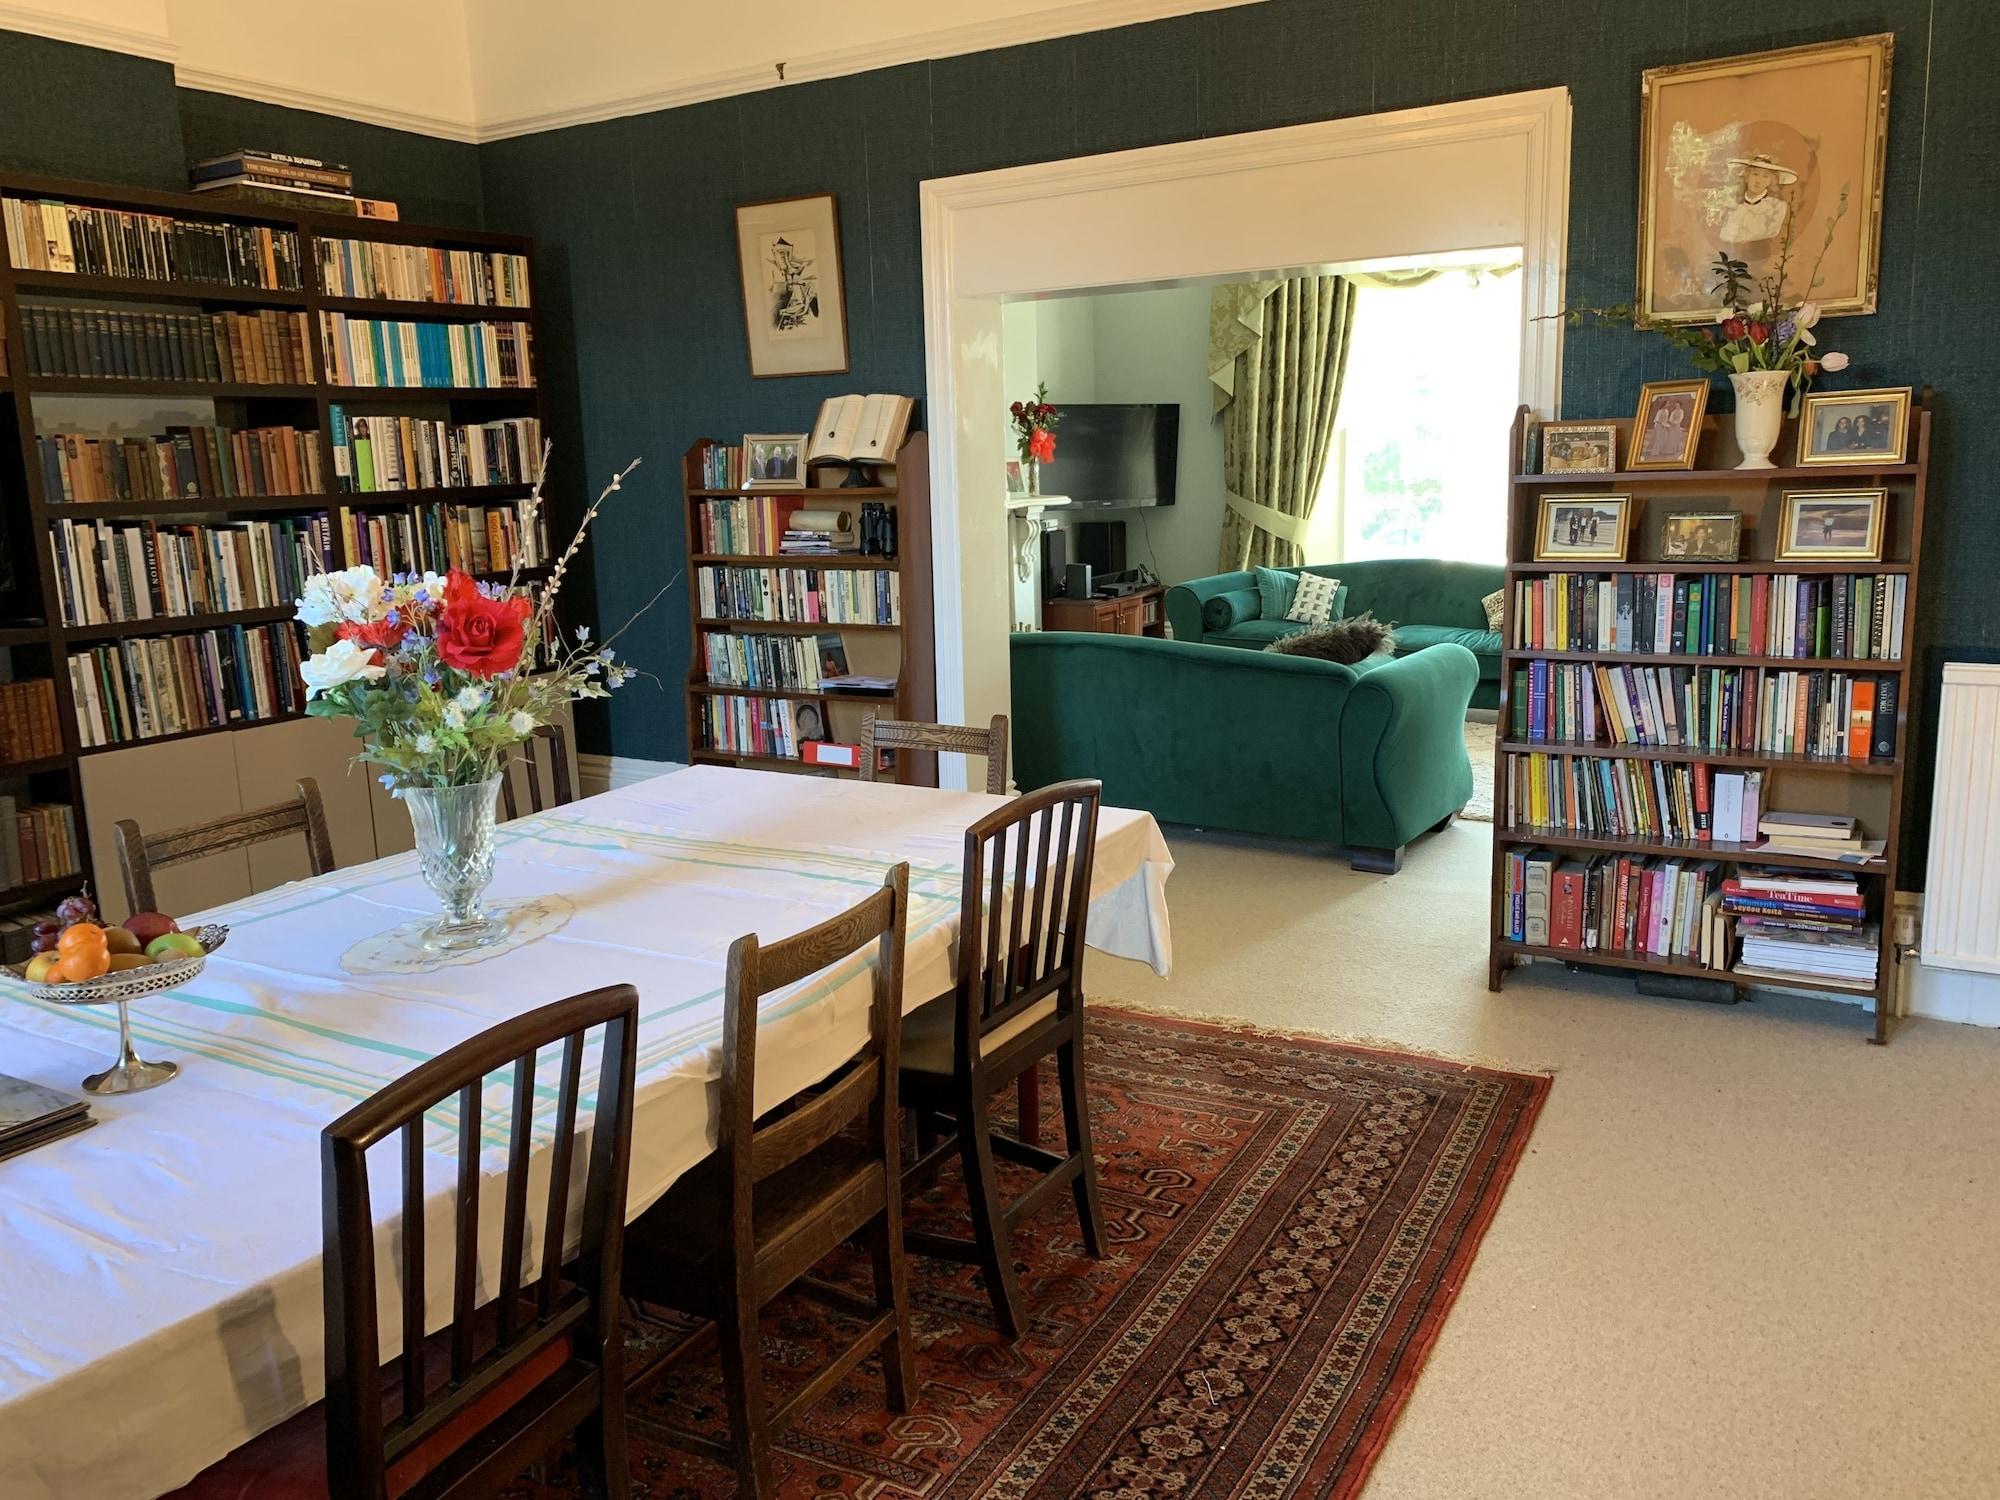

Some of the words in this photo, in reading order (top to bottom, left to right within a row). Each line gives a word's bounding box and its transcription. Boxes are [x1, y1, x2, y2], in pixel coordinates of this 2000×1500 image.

[448, 435, 457, 451] JOHN
[449, 453, 459, 469] PEEL
[320, 517, 331, 551] BRITAIN
[145, 540, 159, 585] FASHION
[1839, 587, 1844, 595] IN
[1658, 595, 1666, 616] SALMAN
[1880, 683, 1888, 712] OXFORD
[1620, 875, 1629, 901] MOTHER
[1618, 901, 1627, 929] COUNTRY
